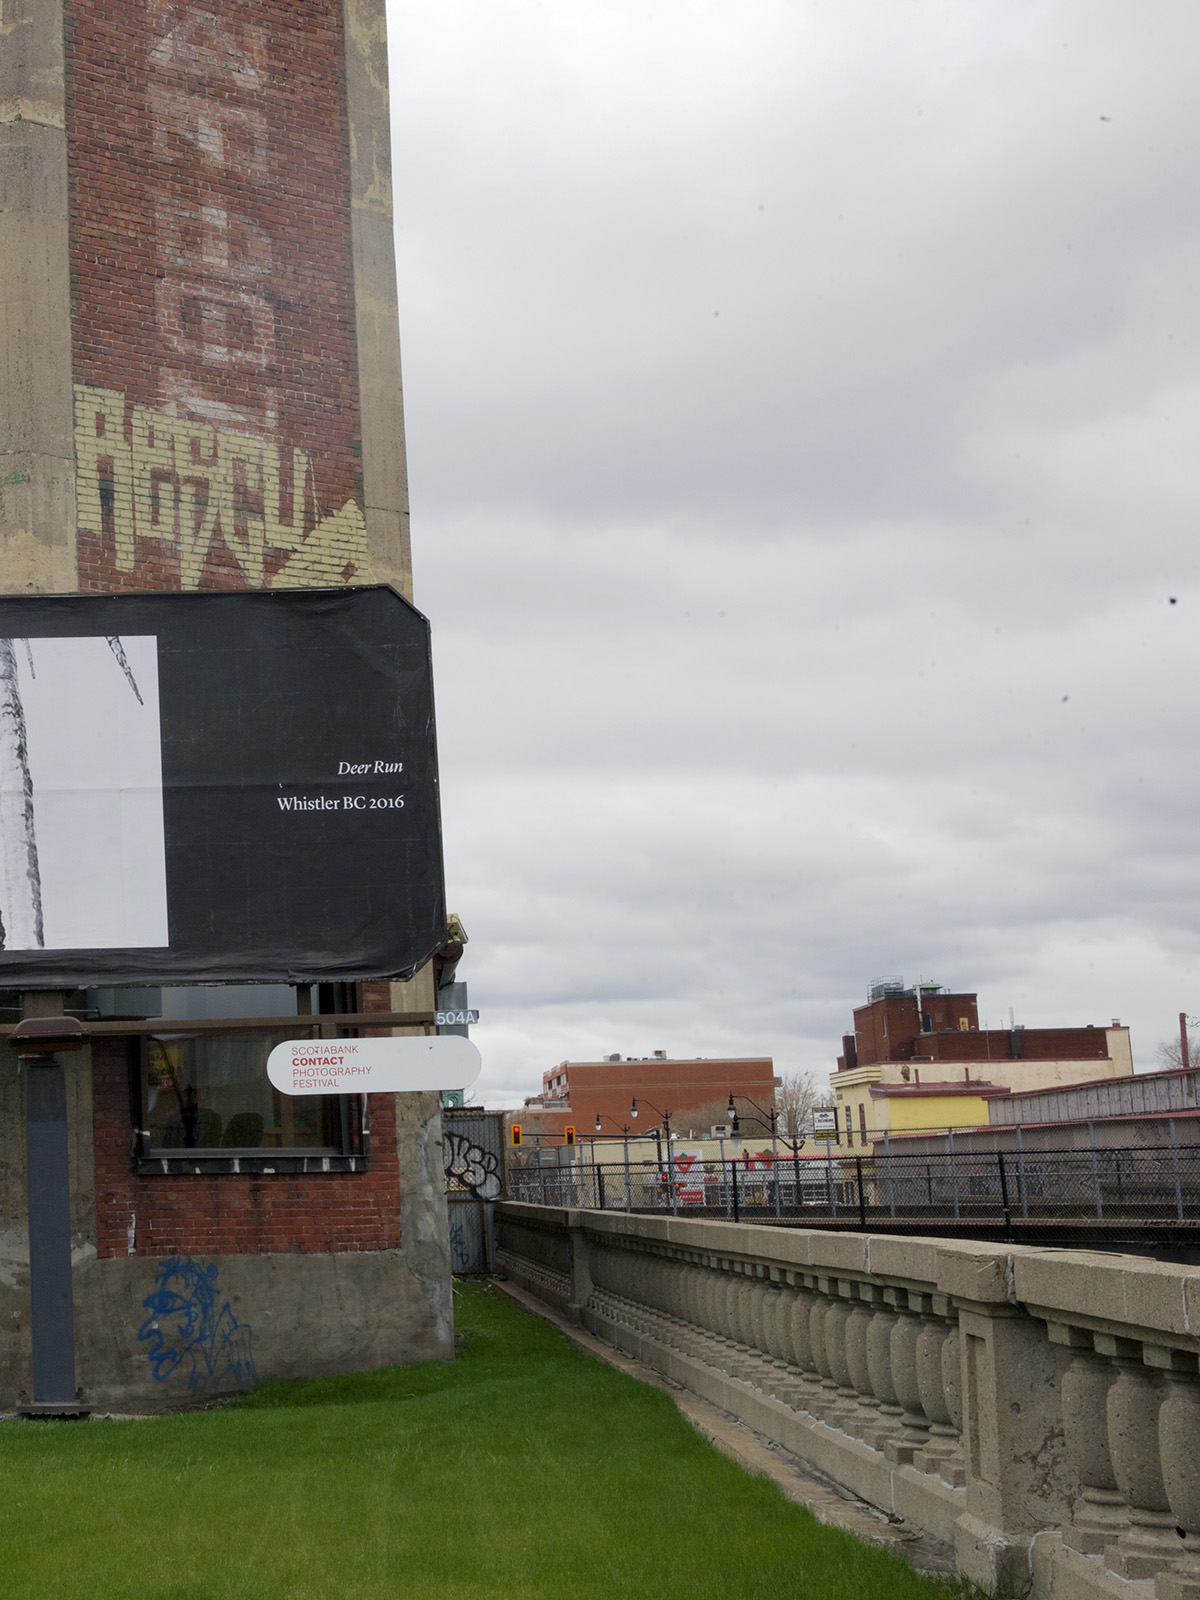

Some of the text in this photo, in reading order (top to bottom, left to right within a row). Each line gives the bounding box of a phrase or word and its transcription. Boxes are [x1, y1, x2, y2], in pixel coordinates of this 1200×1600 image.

[338, 760, 404, 775] Deer Run
[277, 794, 405, 811] Whistler BC 2016
[436, 1011, 477, 1025] 504A
[291, 1045, 359, 1056] SCOTIABANK
[292, 1057, 344, 1067] CONTACT
[292, 1066, 372, 1077] PHOTOGRAPHY
[293, 1079, 340, 1088] FESTIVAL
